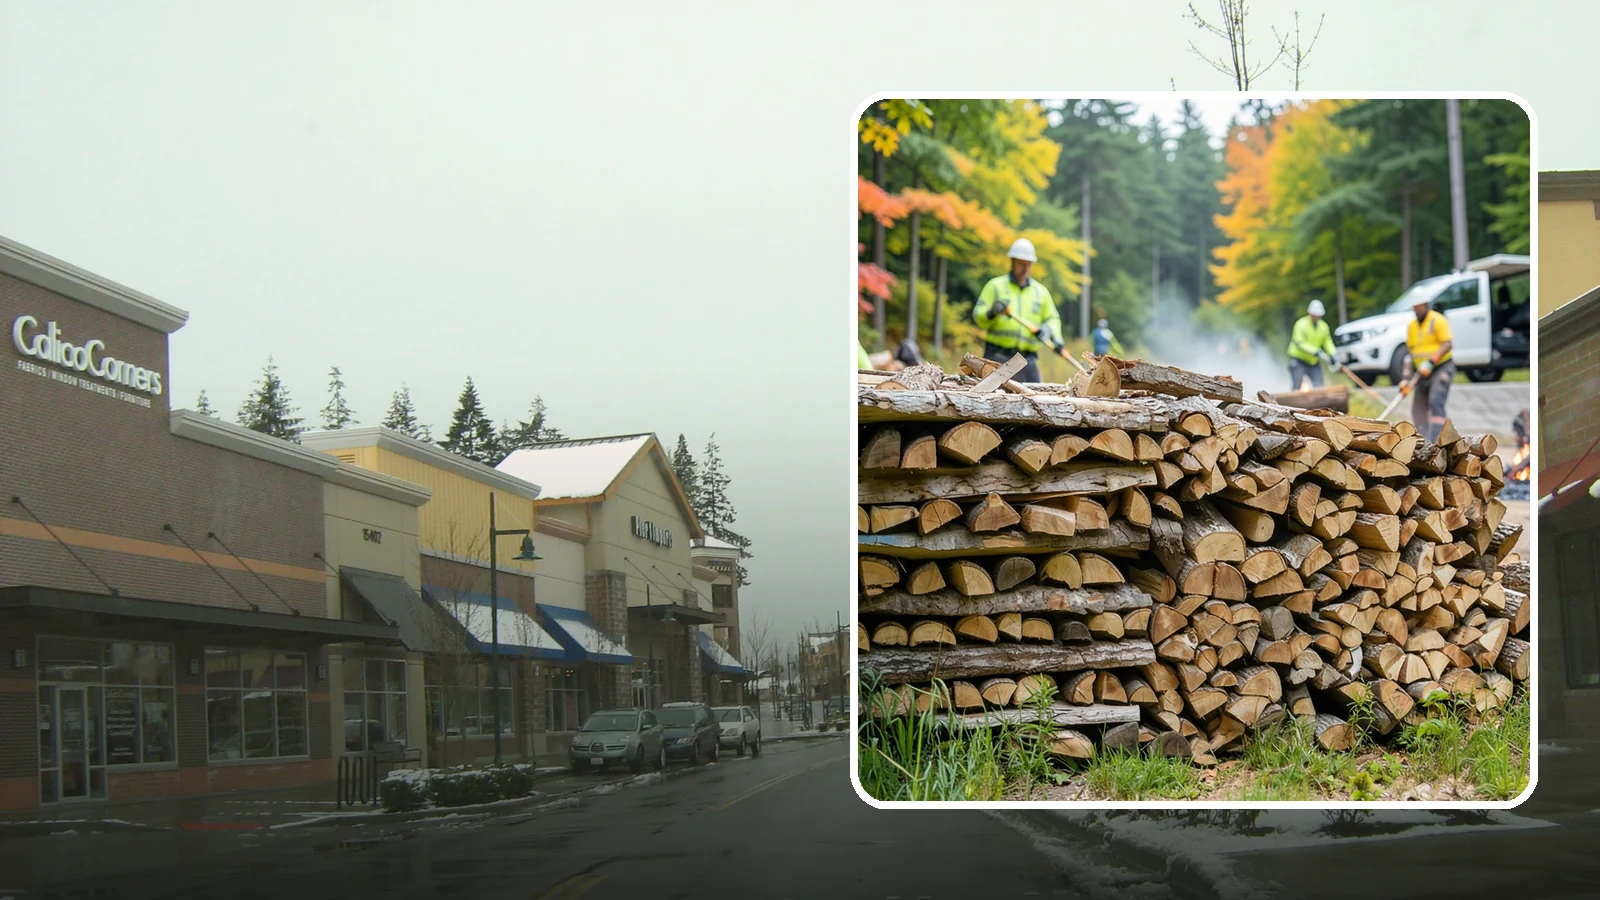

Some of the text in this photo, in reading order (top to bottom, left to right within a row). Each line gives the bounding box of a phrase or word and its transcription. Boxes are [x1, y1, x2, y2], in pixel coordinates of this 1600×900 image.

[17, 360, 151, 408] FABRICS WINDOW TREATMENTS FURNITURE
